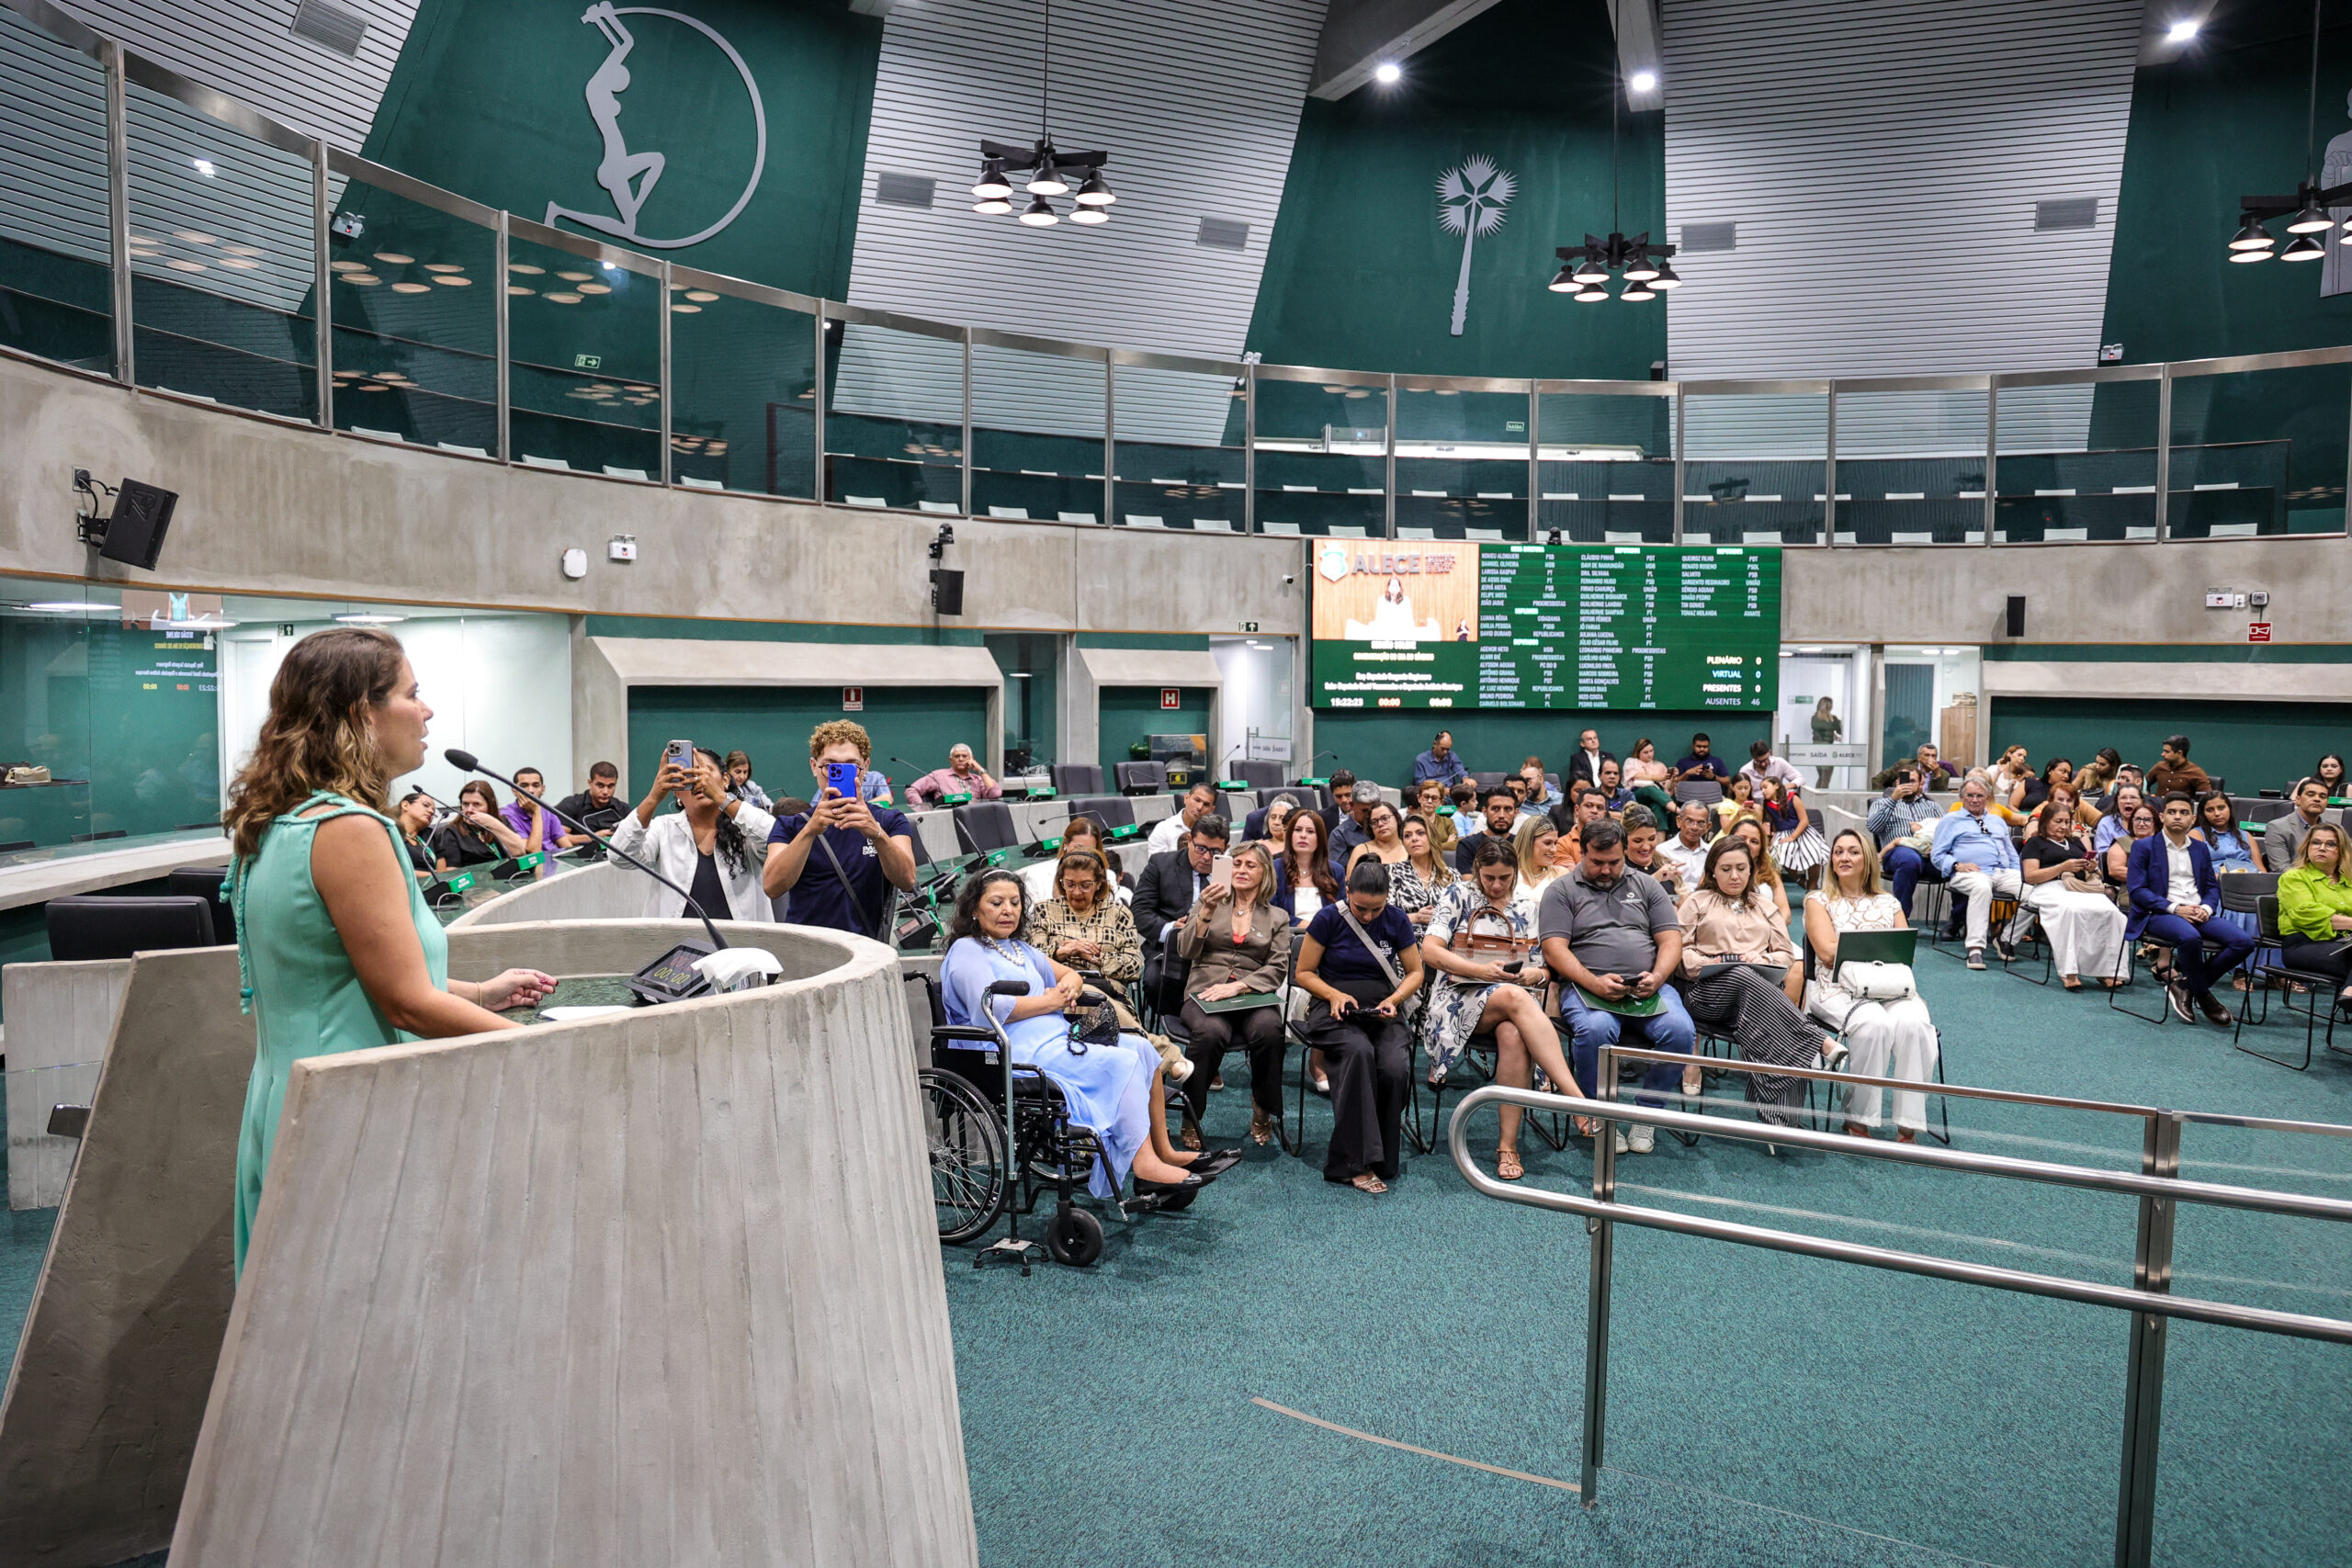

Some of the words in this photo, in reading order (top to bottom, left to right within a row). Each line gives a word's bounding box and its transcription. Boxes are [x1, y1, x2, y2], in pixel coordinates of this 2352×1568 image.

[1351, 554, 1420, 575] ALECE
[1707, 655, 1742, 665] PLENÁRIO
[1755, 657, 1762, 665] 0
[1165, 693, 1175, 705] H
[1331, 698, 1363, 707] 15:22:23
[654, 967, 690, 984] 00:00
